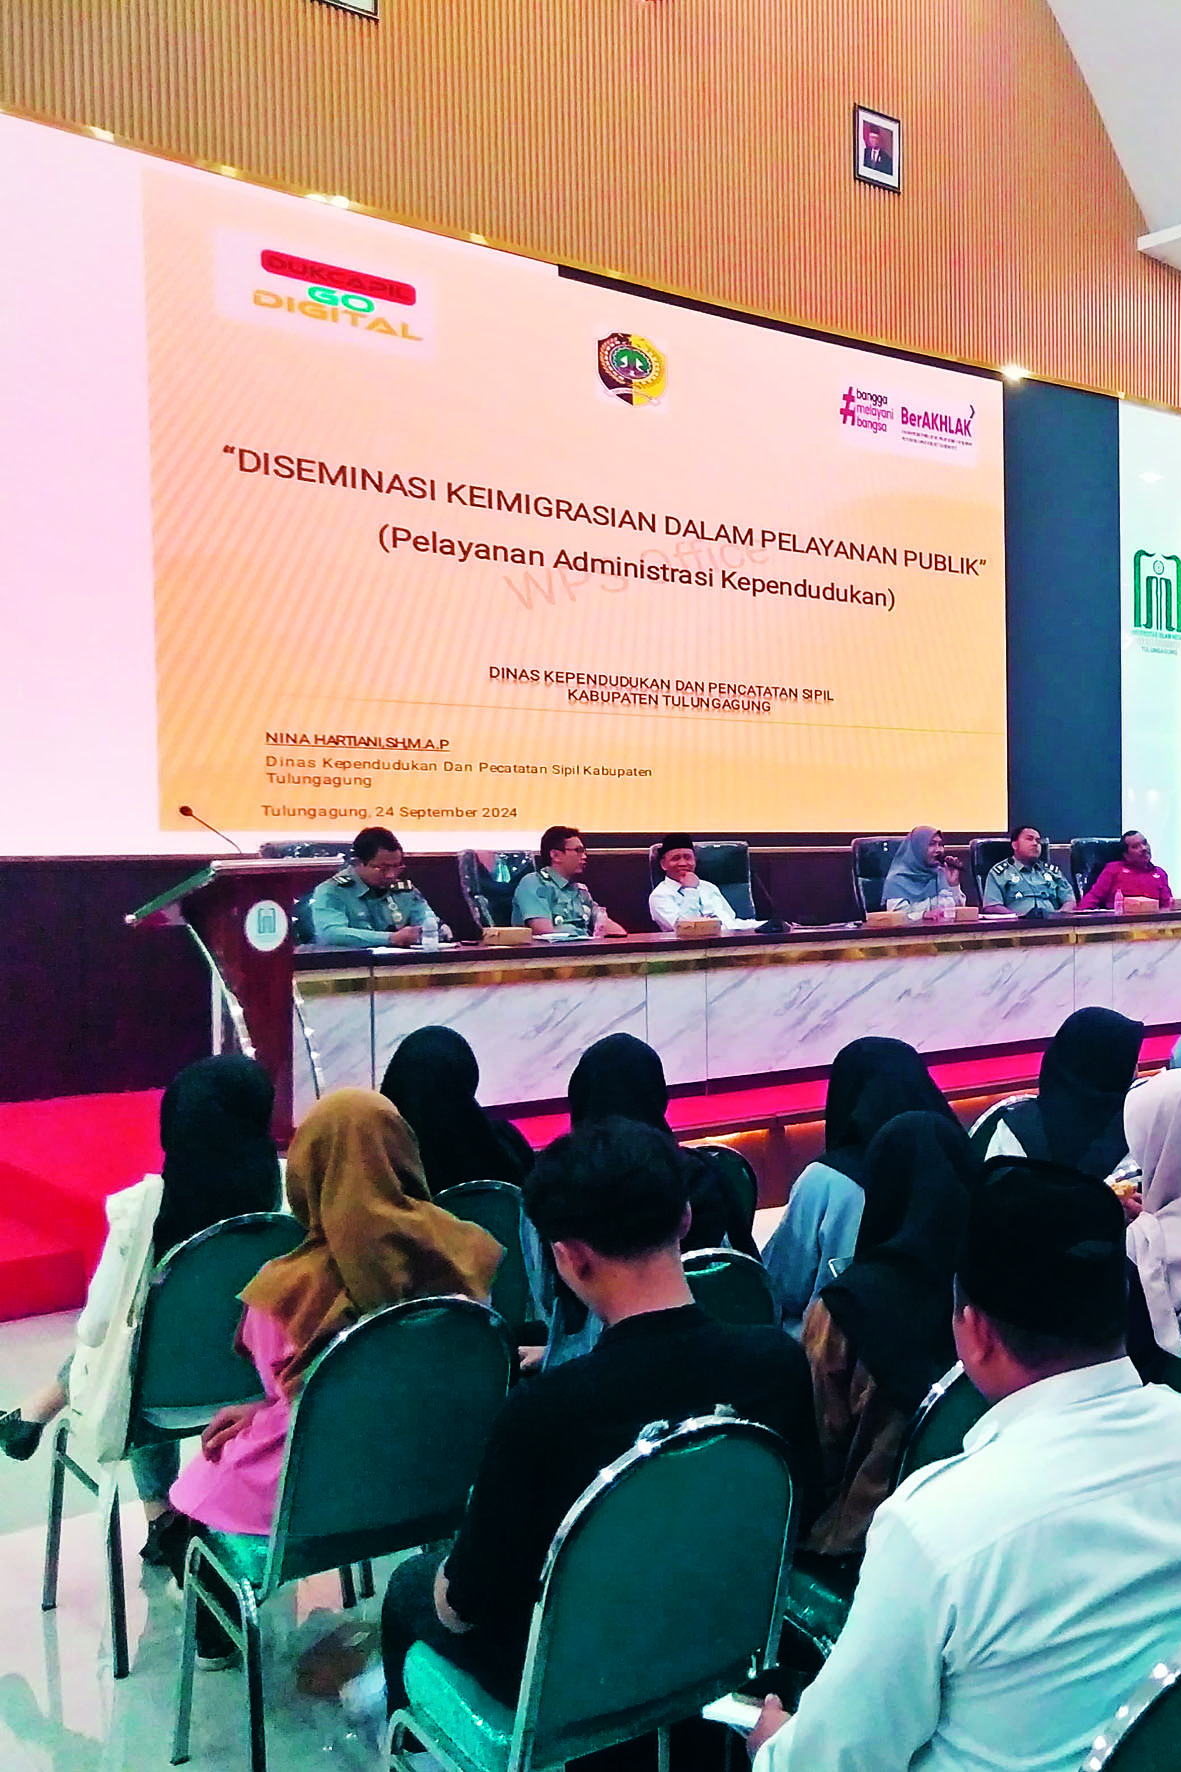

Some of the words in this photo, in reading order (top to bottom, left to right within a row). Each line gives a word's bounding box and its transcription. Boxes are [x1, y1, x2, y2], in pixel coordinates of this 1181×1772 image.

[267, 254, 410, 301] DUKCAPIL
[308, 286, 375, 313] GO
[252, 289, 423, 341] DIGITAL
[856, 388, 888, 407] bangga
[856, 403, 894, 421] melayani
[901, 406, 972, 438] BerAKHLAK
[856, 416, 888, 434] bangsa
[447, 481, 656, 533] KEIMIGRASIAN
[665, 516, 754, 547] DALAM
[761, 530, 897, 567] PELAYANAN
[378, 522, 545, 567] (Pelayanan
[553, 548, 713, 588] Administrasi
[721, 568, 896, 612] Kependudukan)
[489, 666, 541, 682] DINAS
[544, 670, 671, 691] KEPENDUDUKAN
[675, 679, 705, 693] DAN
[708, 682, 798, 699] PENCATATAN
[802, 688, 834, 702] SIPIL
[568, 689, 659, 706] KABUPATEN
[662, 694, 771, 712] TULUNGAGUNG
[265, 731, 311, 744] NINA
[265, 755, 317, 769] Dinas
[322, 757, 438, 772] Kependudukan
[443, 761, 473, 773] Dan
[479, 762, 548, 775] Pecatatan
[552, 764, 580, 777] Sipil
[583, 765, 652, 779] Kabupaten
[266, 772, 372, 788] Tulungagung
[375, 806, 395, 818] 24
[399, 806, 478, 820] September
[482, 807, 518, 818] 2024
